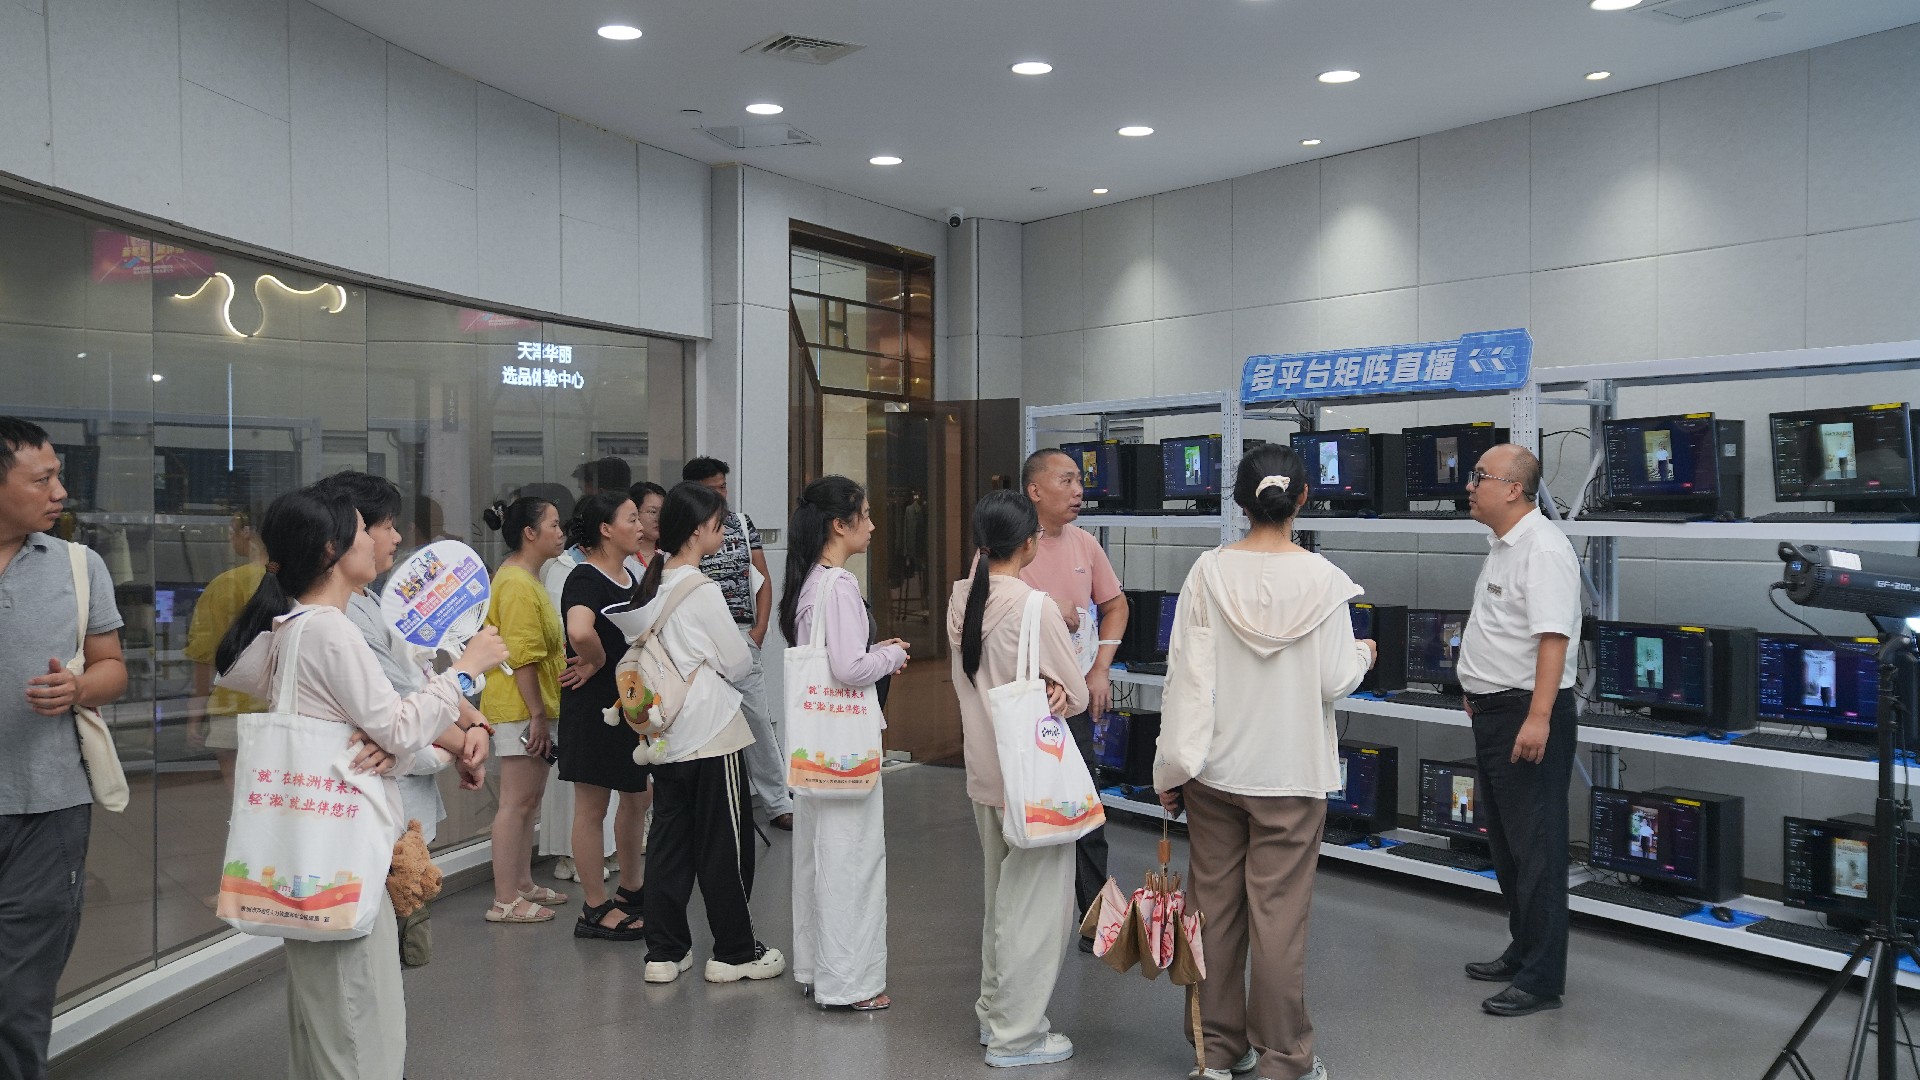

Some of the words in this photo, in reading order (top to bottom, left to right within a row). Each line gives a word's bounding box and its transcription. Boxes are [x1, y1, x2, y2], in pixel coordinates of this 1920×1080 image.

[502, 365, 585, 389] 选品体验中心
[1251, 348, 1458, 392] 多平台矩阵直播
